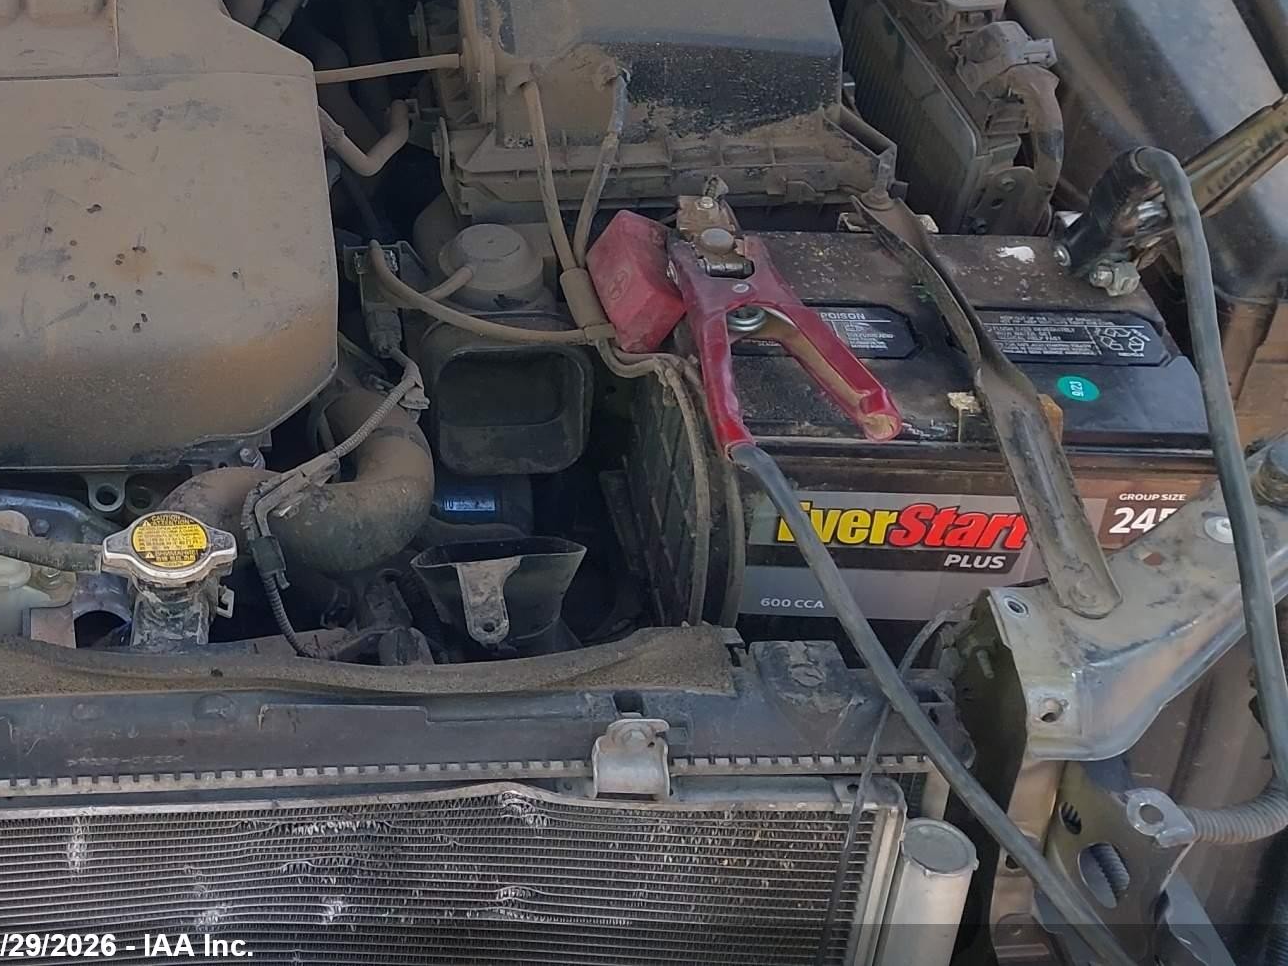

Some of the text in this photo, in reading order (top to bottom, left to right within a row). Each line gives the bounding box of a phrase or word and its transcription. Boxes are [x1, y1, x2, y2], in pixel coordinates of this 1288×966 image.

[820, 312, 865, 320] POISON
[1119, 493, 1187, 501] GROUP SIZE
[944, 553, 1006, 569] PLUS
[761, 598, 824, 609] 600 CCA
